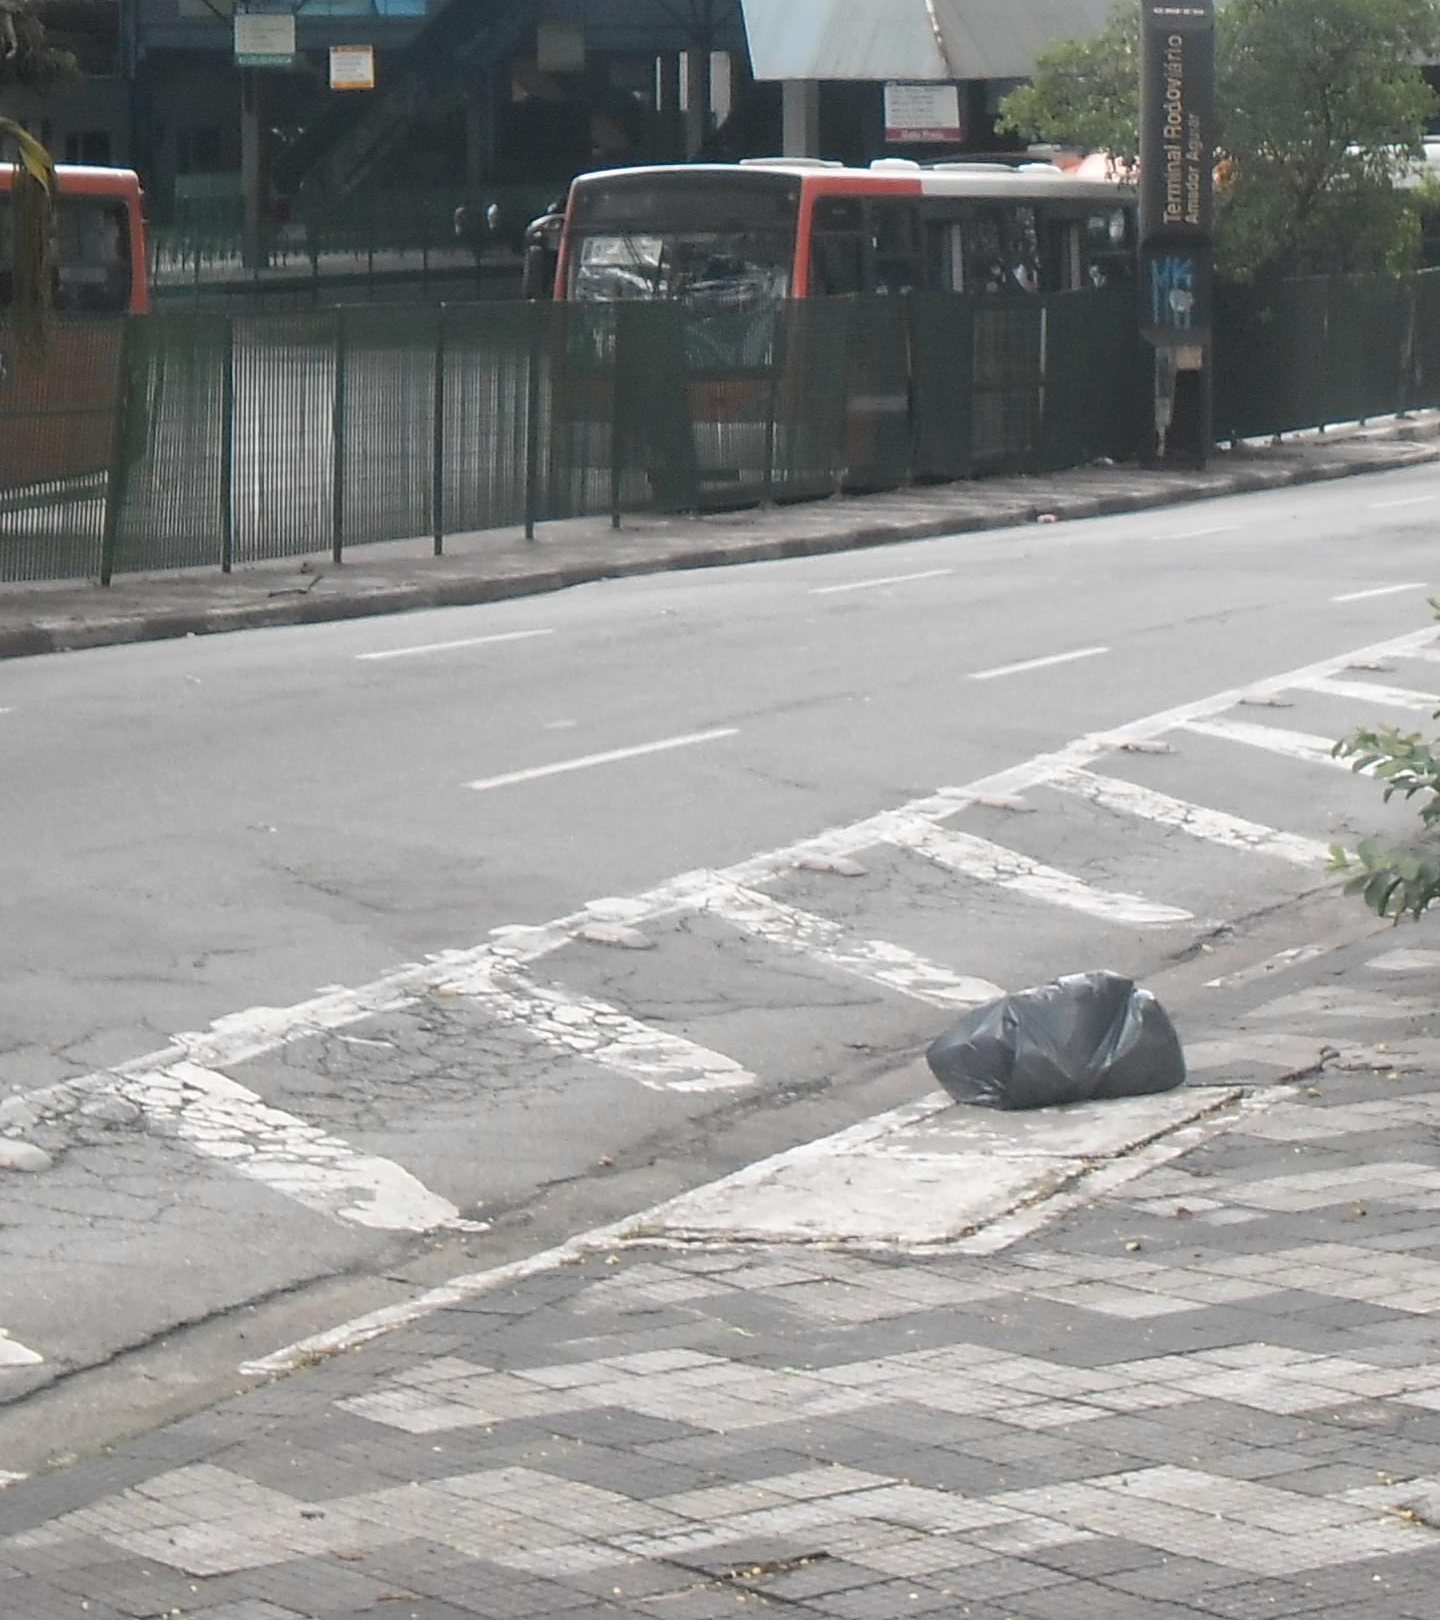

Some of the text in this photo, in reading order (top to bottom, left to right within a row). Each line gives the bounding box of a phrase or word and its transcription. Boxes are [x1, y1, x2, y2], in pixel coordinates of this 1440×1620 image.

[1162, 35, 1183, 224] Terminal Rodoviário
[1185, 165, 1201, 224] Amador
